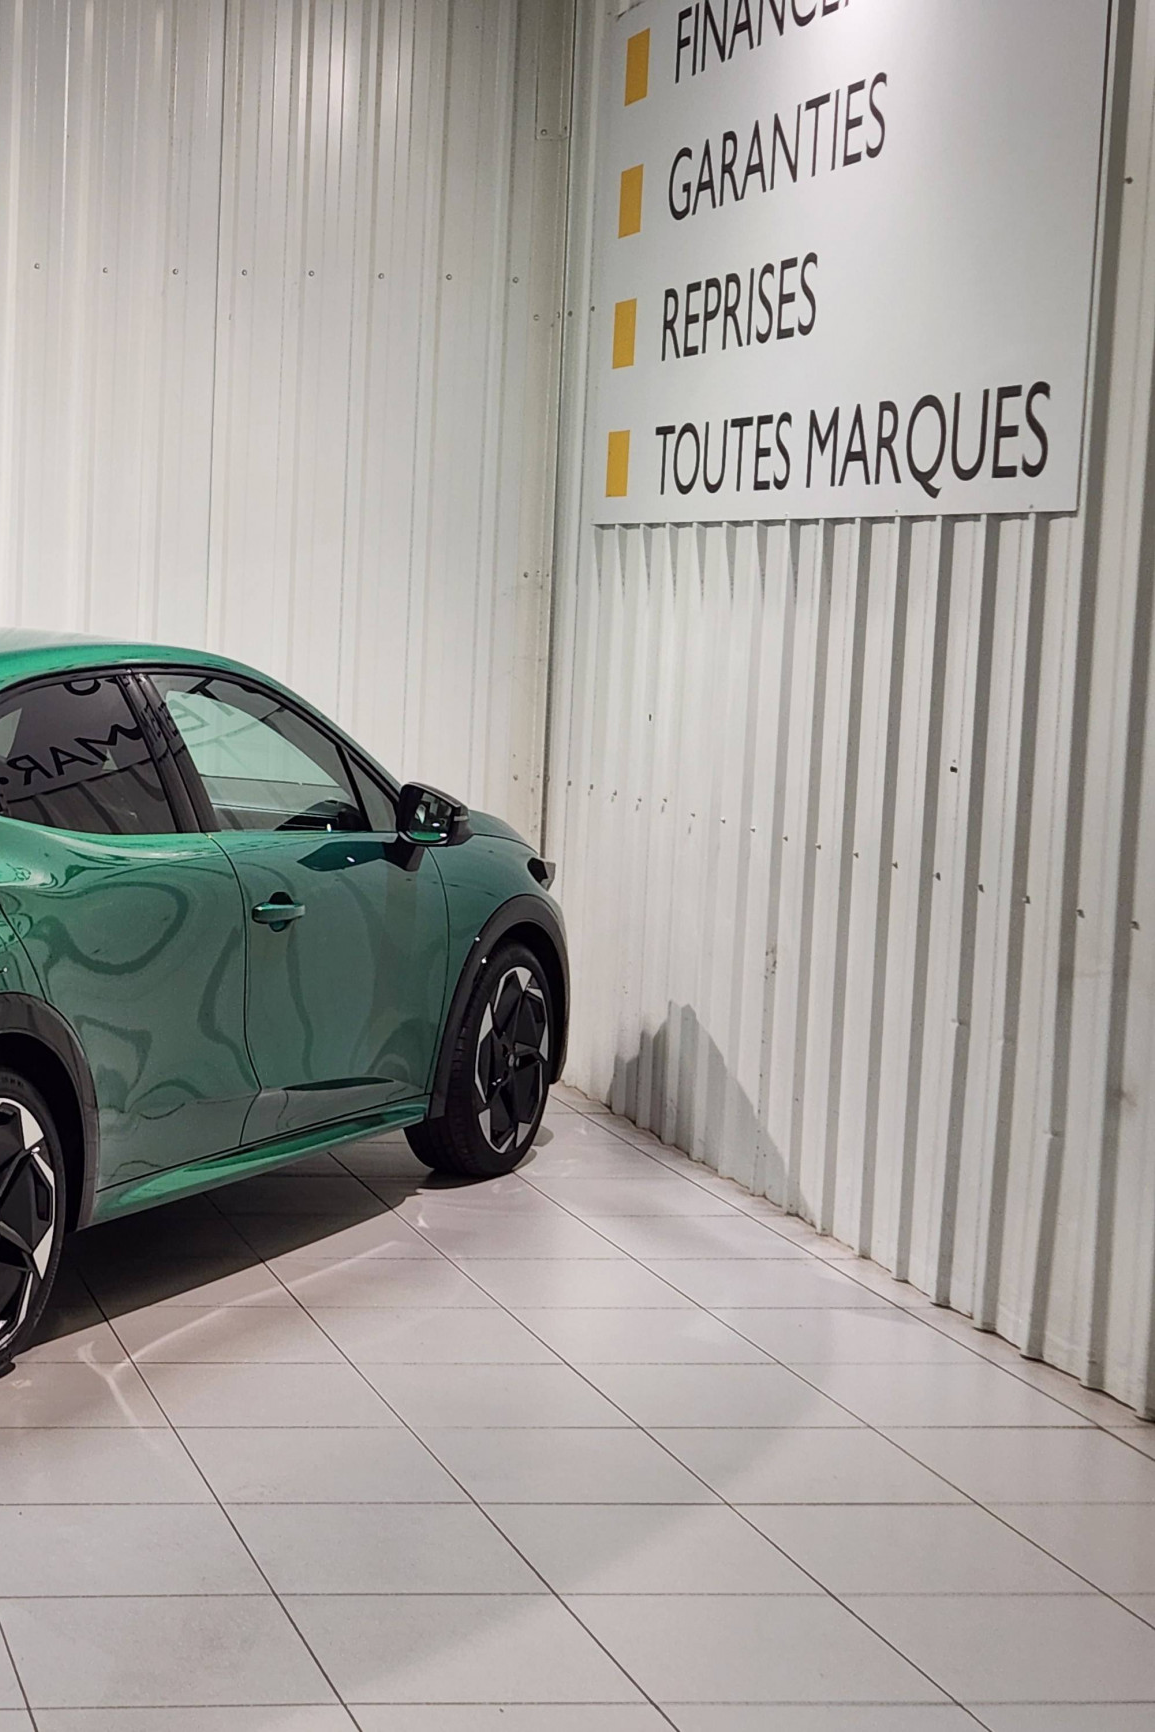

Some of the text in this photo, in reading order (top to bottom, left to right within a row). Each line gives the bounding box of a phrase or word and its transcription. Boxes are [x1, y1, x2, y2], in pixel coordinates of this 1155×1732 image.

[674, 0, 850, 84] FINAN
[668, 72, 888, 221] GARANTIES
[661, 252, 818, 362] REPRISES
[655, 381, 1051, 499] TOUTES MARQUES
